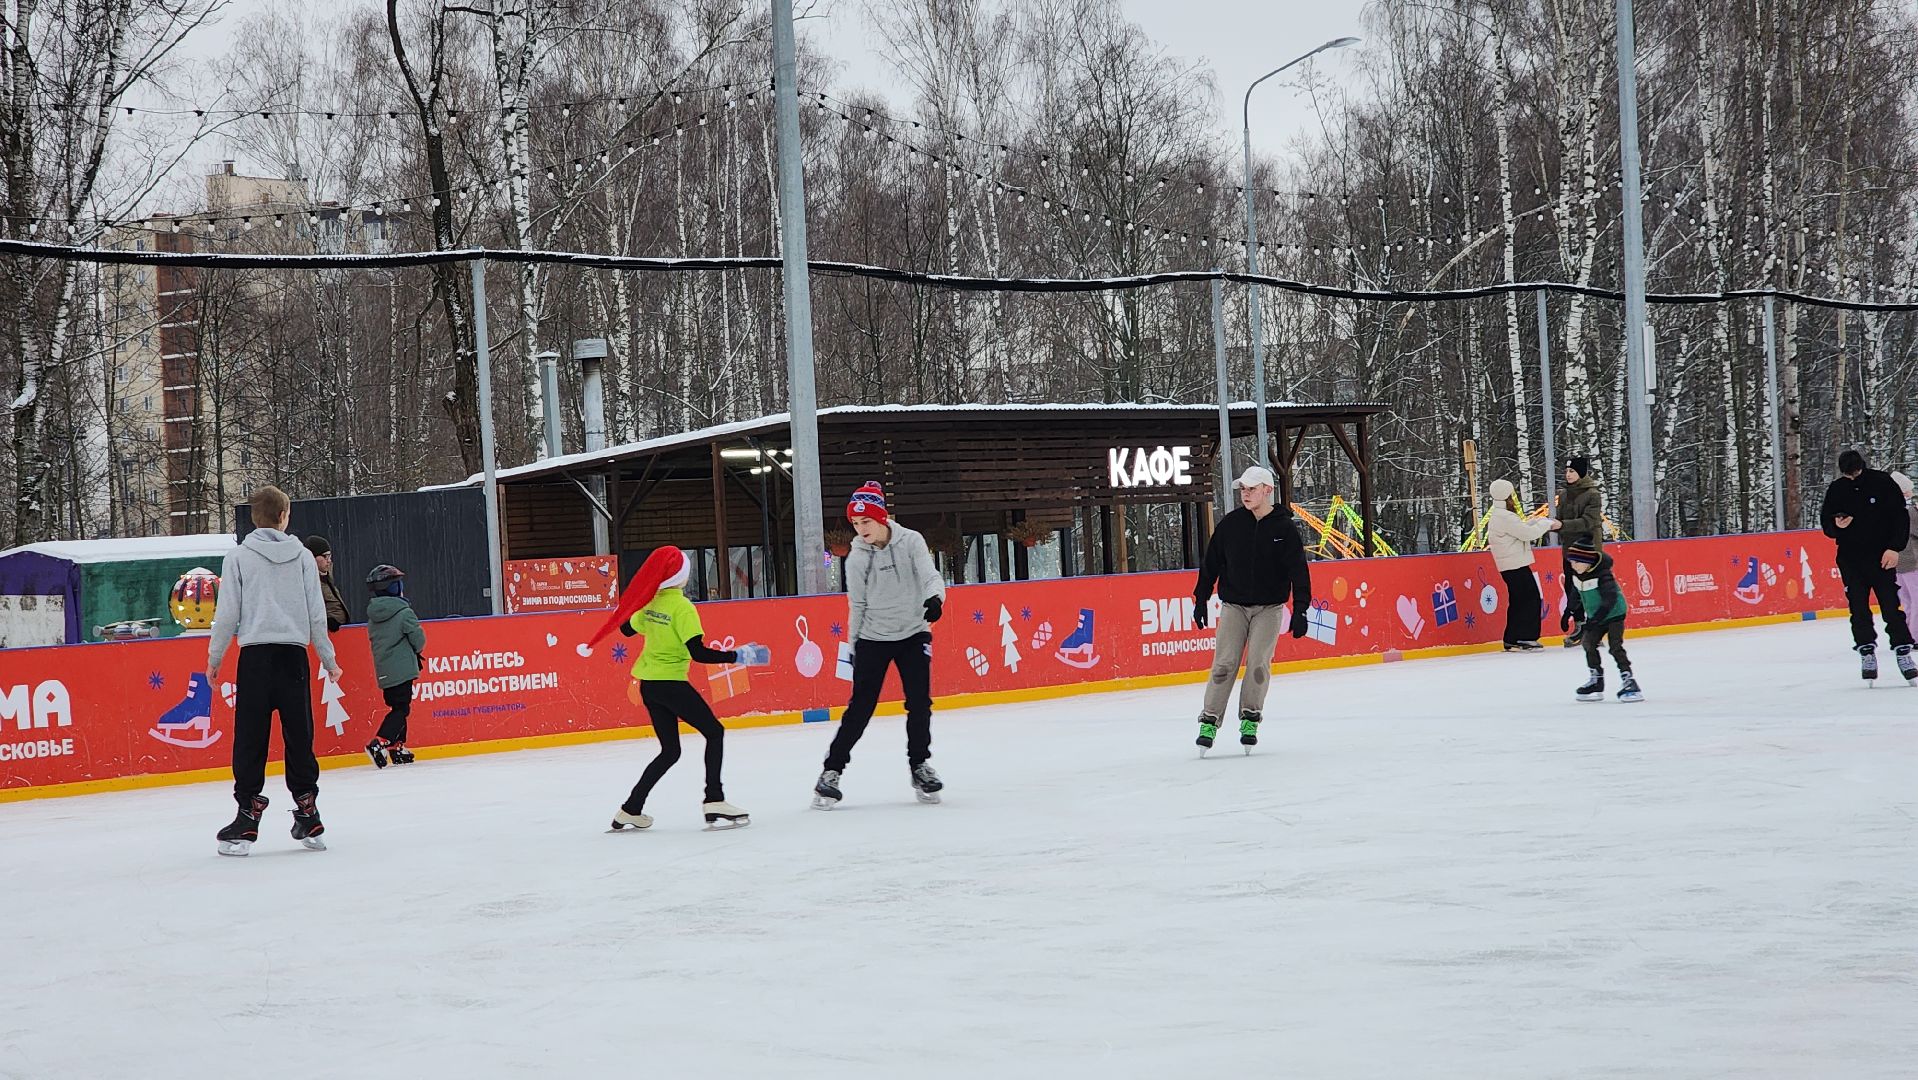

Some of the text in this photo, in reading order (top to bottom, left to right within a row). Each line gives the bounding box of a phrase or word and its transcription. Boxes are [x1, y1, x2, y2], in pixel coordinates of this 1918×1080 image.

[1108, 446, 1192, 488] КАФЕ
[522, 594, 602, 606] ЗИМА В ПОДМОСКОВЬЕ
[428, 650, 525, 674] КАТАЙТЕСЬ
[1142, 643, 1150, 657] В
[411, 672, 558, 702] УДОВОЛЬСТВИЕМ!
